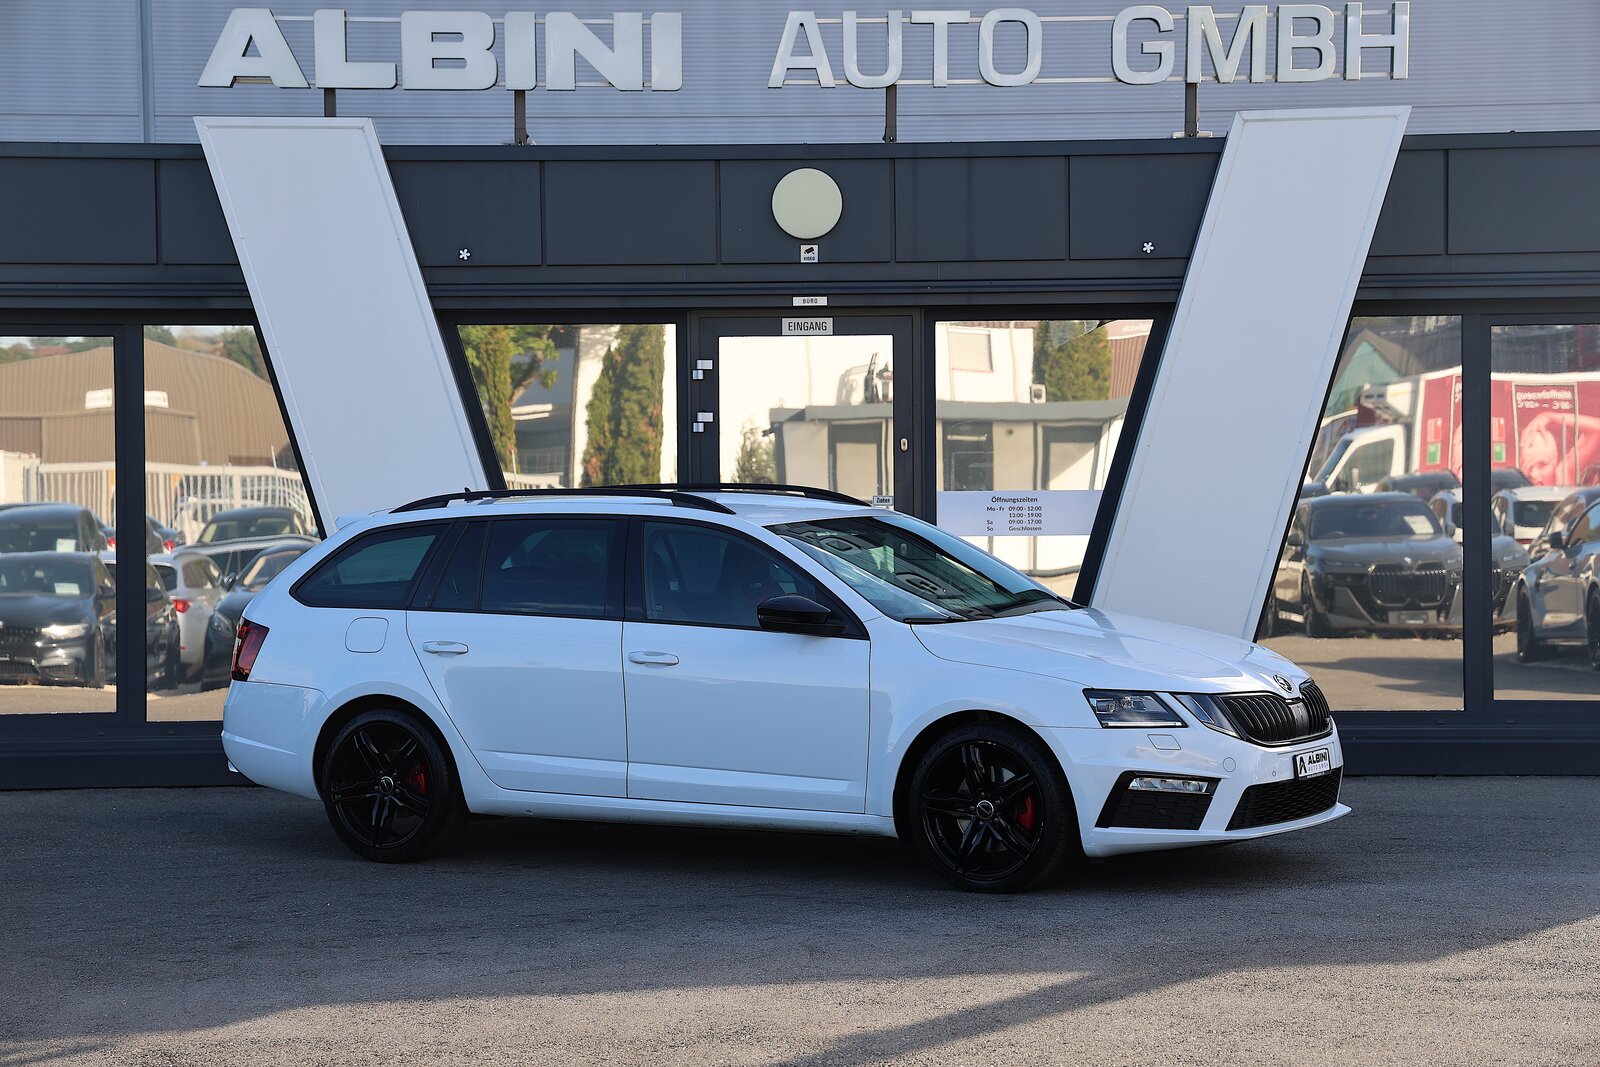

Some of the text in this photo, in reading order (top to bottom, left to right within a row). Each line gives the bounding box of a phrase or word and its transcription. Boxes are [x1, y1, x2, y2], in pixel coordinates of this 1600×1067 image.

[197, 1, 1410, 91] ALBINI AUTO GMBH
[788, 321, 828, 332] EINGANG
[1308, 752, 1328, 765] ALBINI
